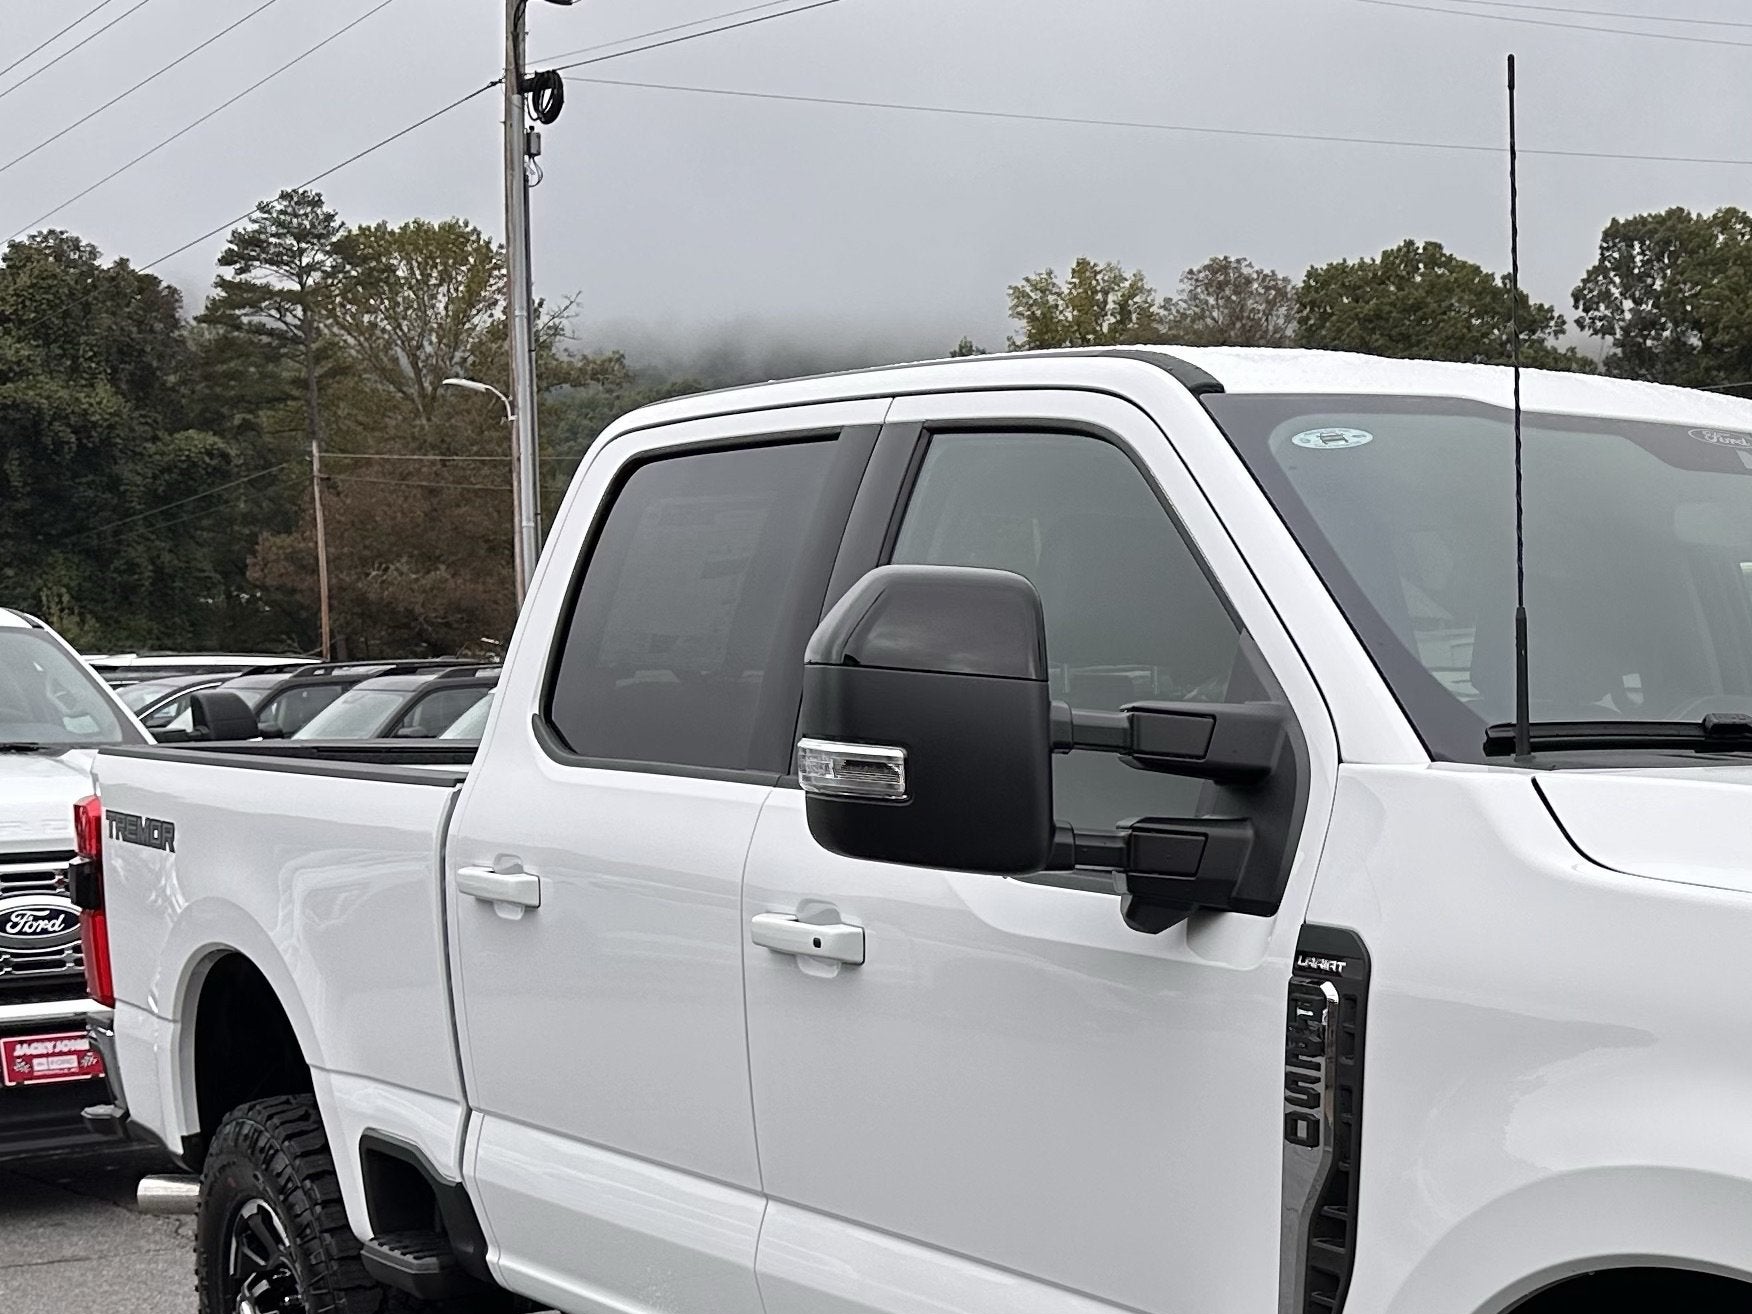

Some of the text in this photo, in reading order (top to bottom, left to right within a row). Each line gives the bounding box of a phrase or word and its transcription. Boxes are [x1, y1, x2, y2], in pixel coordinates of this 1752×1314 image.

[105, 809, 175, 853] TREMOR
[5, 909, 66, 934] Ford
[1297, 955, 1347, 973] LARIAT
